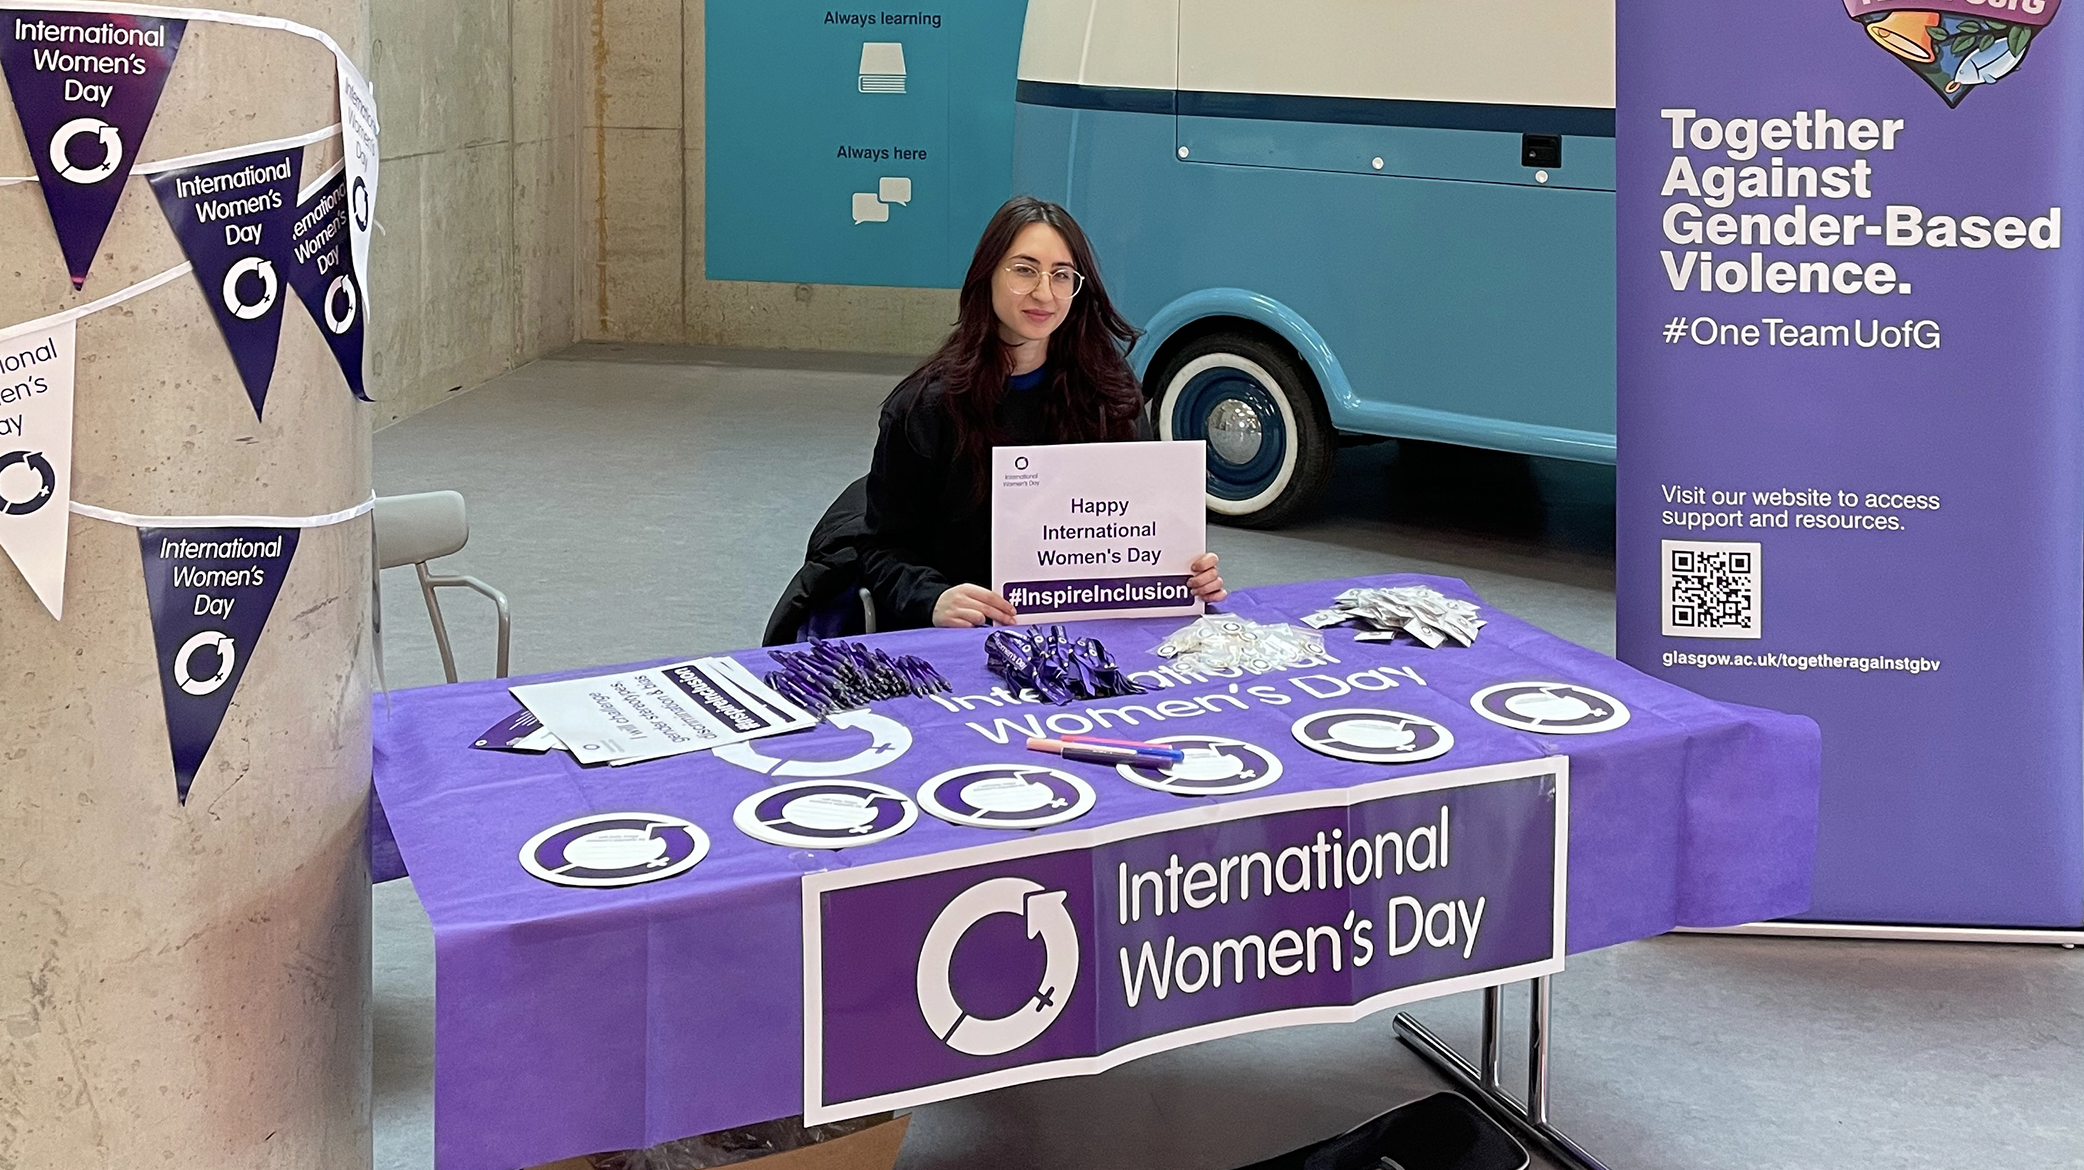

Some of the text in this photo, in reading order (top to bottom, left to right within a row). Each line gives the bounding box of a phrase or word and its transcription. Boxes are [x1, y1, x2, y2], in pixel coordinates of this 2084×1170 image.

[15, 18, 164, 47] International
[824, 11, 942, 28] Always learning
[33, 49, 146, 74] Women's
[64, 80, 113, 107] Day
[1661, 109, 1905, 161] Together
[837, 146, 927, 162] Always here
[176, 157, 291, 198] International
[1661, 156, 1872, 208] Against
[196, 190, 282, 223] Women's
[225, 223, 262, 245] Day
[294, 210, 347, 264] Women's
[1662, 203, 2061, 249] Gender-Based
[317, 245, 339, 275] Day
[1661, 250, 1912, 294] Violence.
[0, 375, 48, 406] en's
[1071, 498, 1129, 516] Happy
[1662, 485, 1940, 510] Visit our website to access
[1043, 521, 1156, 540] International
[1662, 509, 1905, 530] support and resources.
[159, 536, 282, 560] International
[1038, 548, 1161, 566] Women's Day
[173, 565, 264, 588] Women's
[194, 594, 235, 619] Day
[1008, 582, 1188, 608] #InspireInclusion
[1662, 651, 1941, 673] glasgow.ac.uk/togetheragainstgbv
[674, 667, 761, 730] #InspireInclusion
[965, 666, 1427, 744] Women's Day
[657, 694, 718, 739] discrimination
[1117, 804, 1450, 926] International
[1118, 895, 1486, 1009] Women's Day
